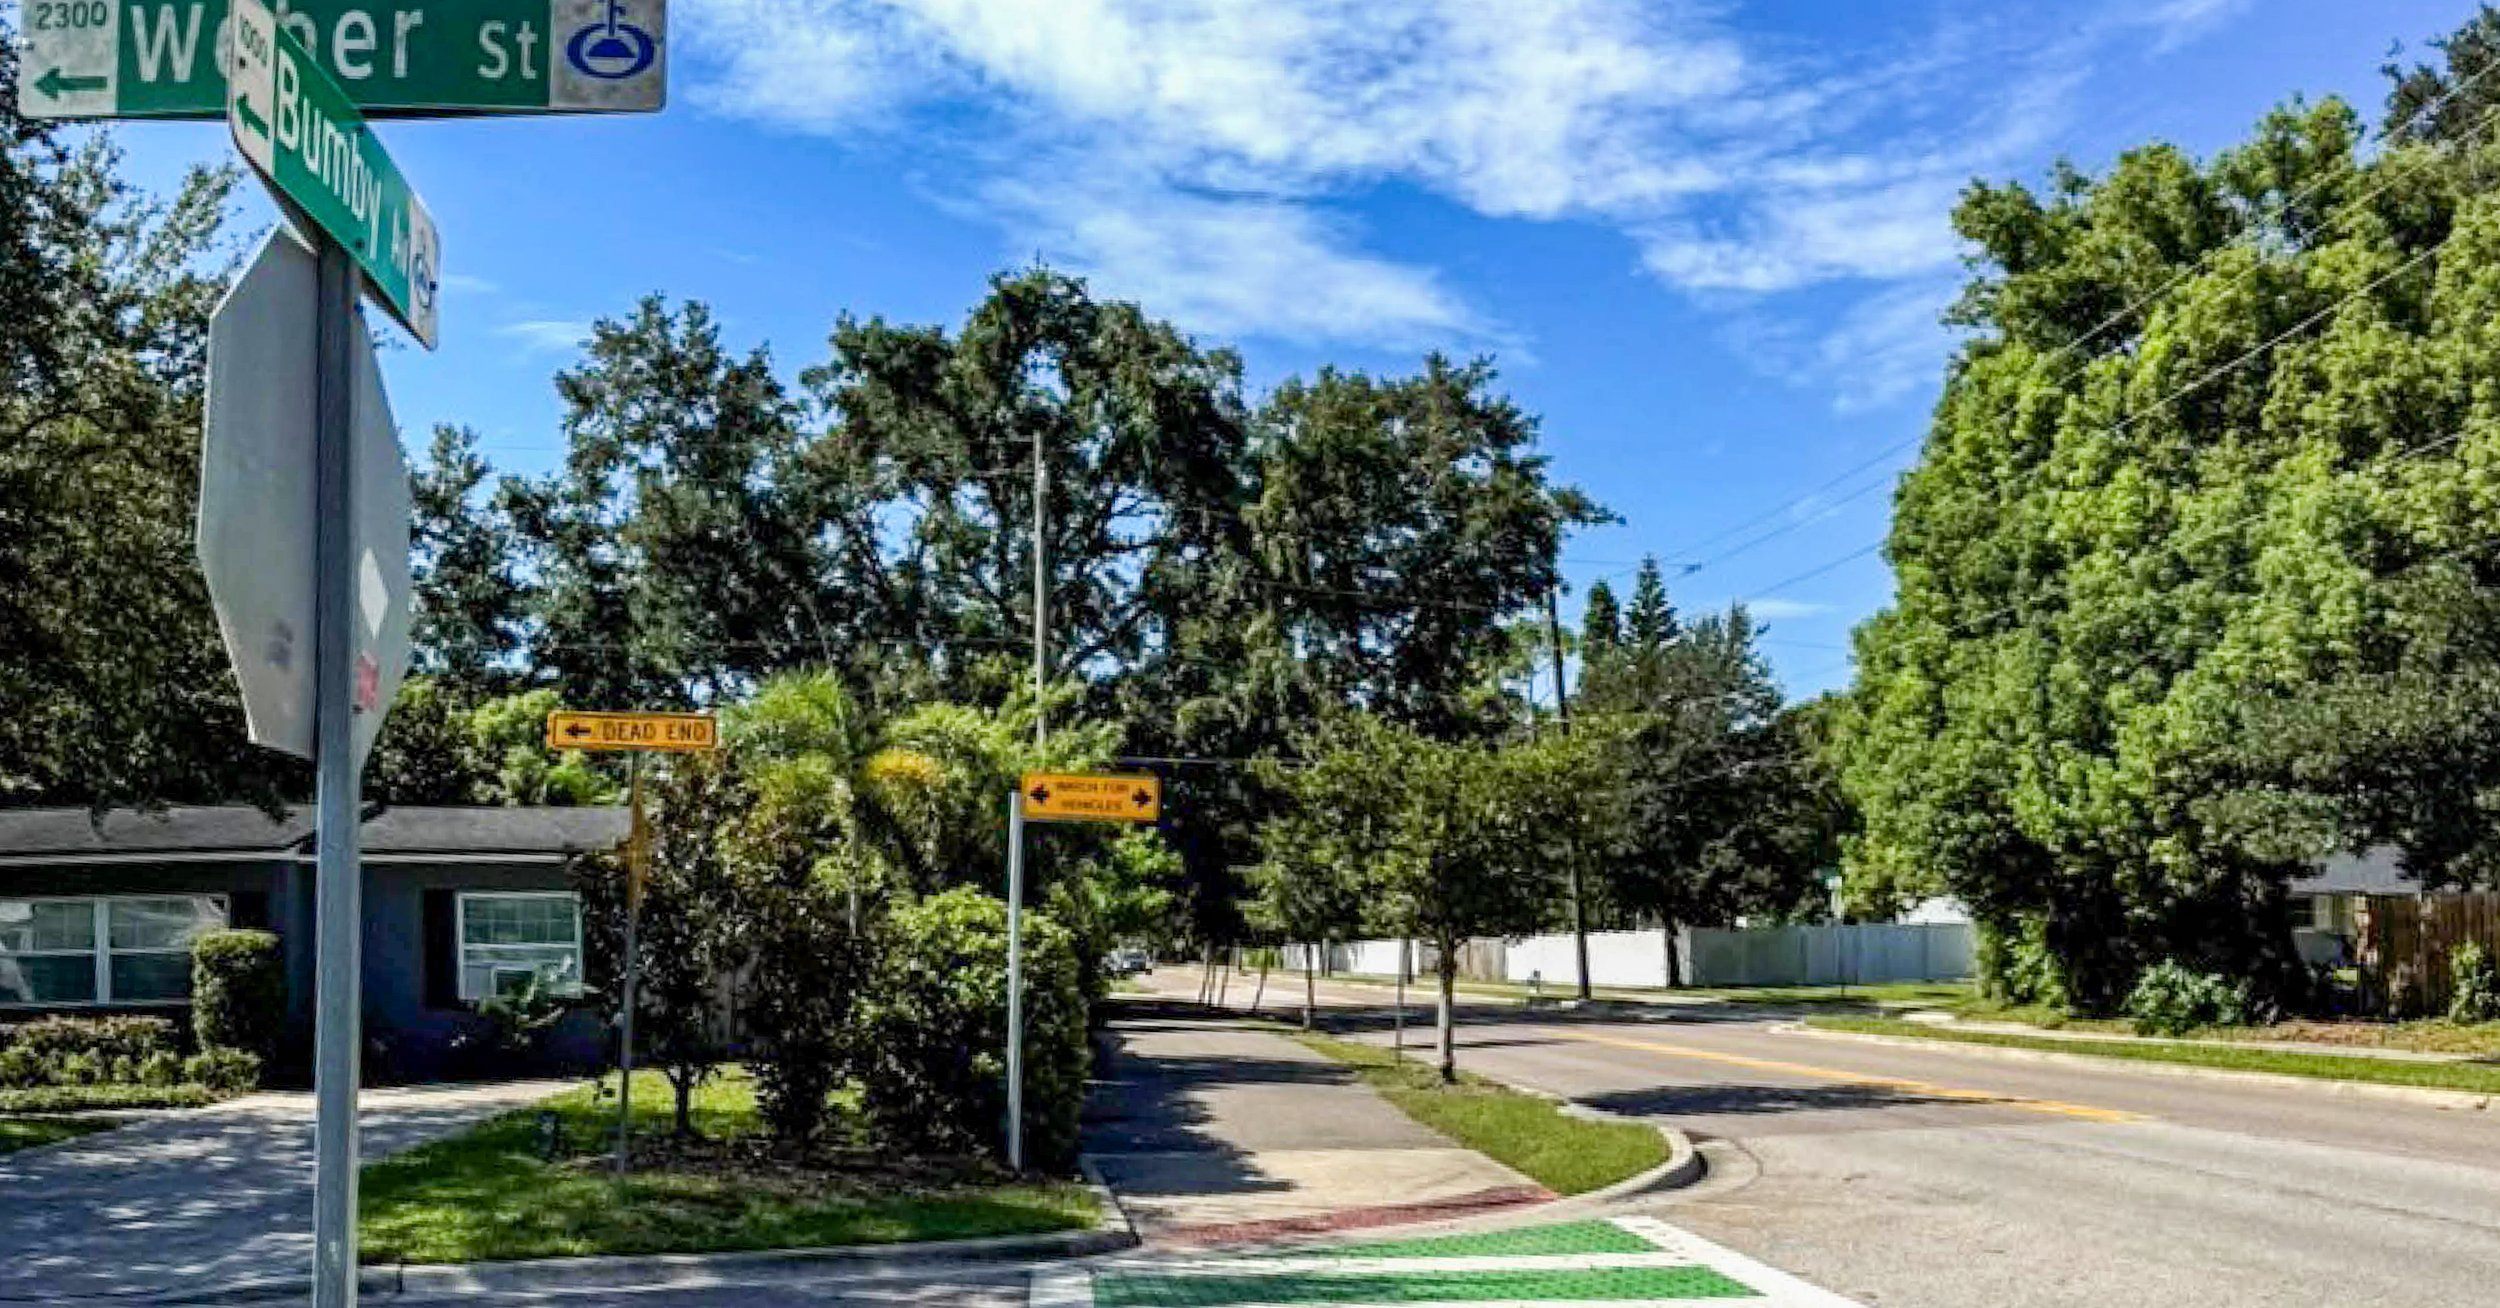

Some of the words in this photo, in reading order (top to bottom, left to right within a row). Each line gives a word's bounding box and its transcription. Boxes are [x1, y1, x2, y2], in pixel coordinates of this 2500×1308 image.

[36, 2, 107, 30] 2300
[277, 48, 382, 261] Bumby
[602, 720, 657, 742] DEAD
[666, 720, 707, 742] END
